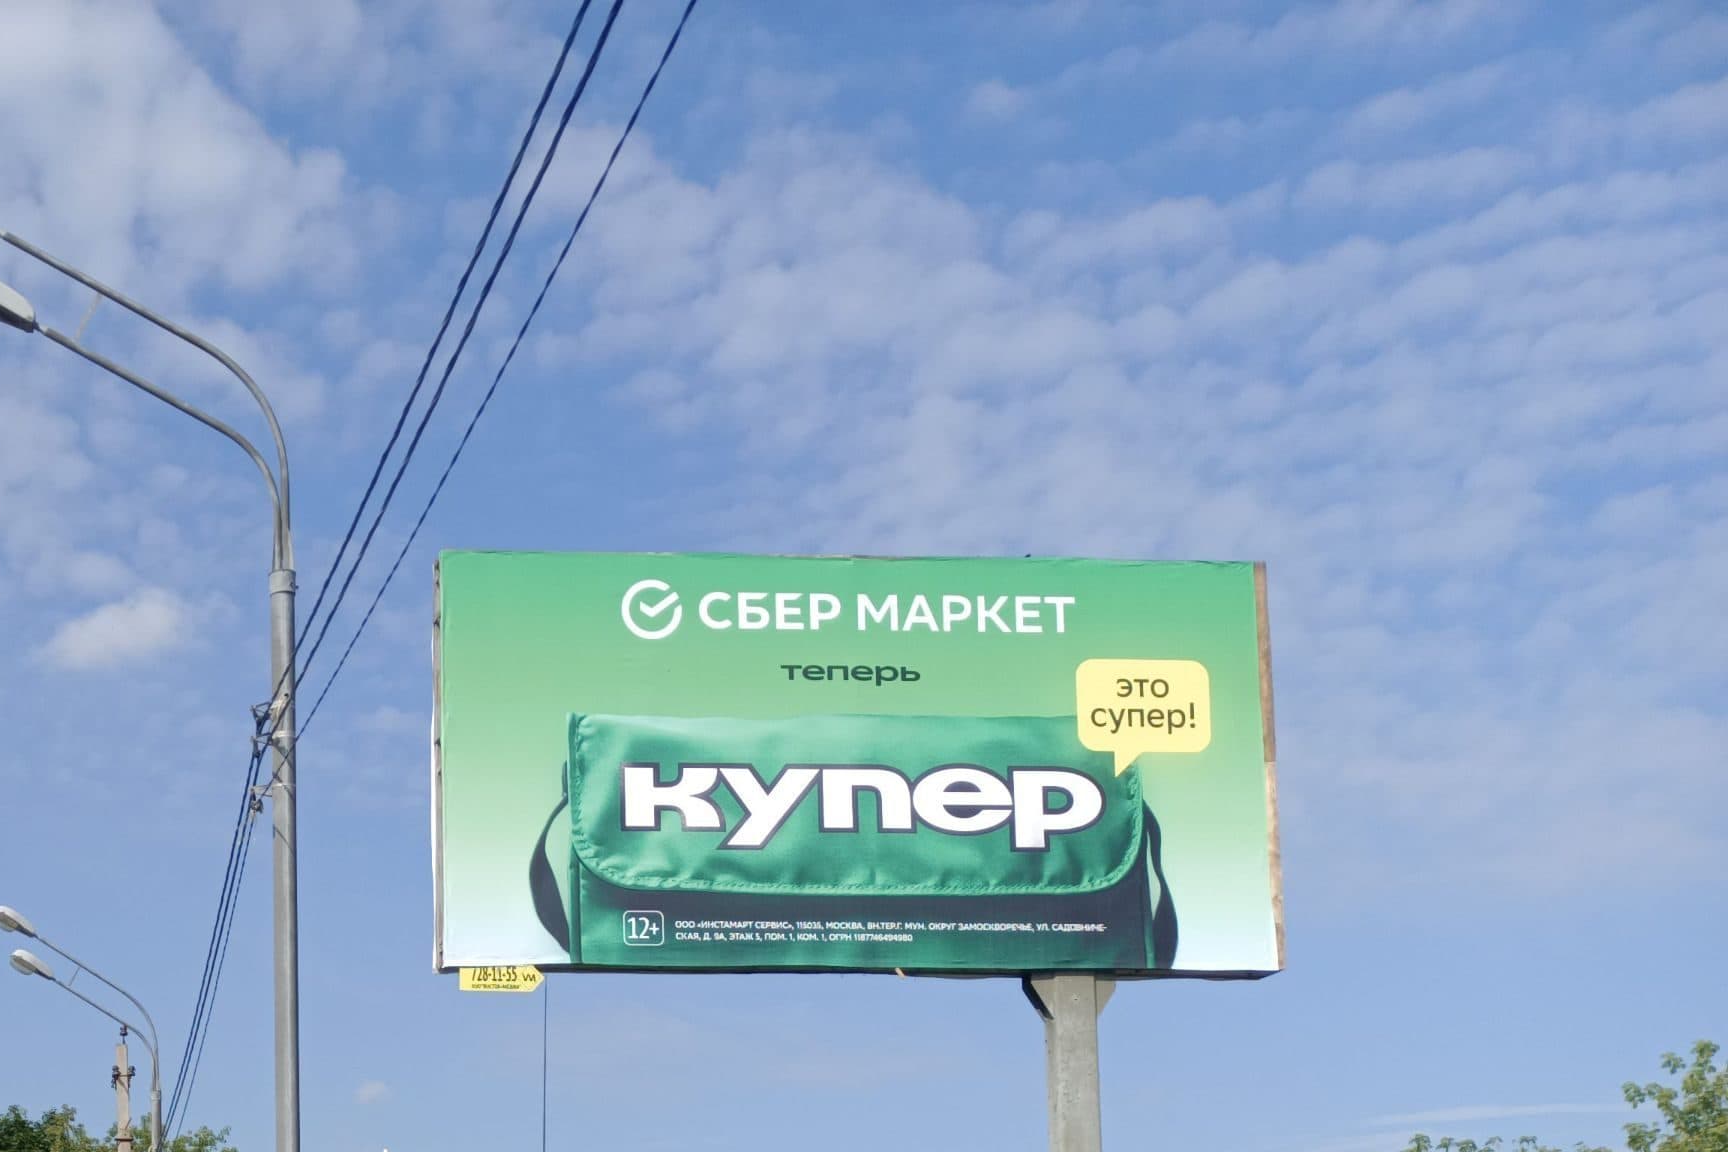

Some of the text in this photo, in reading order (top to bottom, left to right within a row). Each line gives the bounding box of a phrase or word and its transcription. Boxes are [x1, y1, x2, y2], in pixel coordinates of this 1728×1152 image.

[698, 591, 1077, 634] СБЕР МАРКЕТ
[779, 663, 922, 687] теперь
[1116, 678, 1170, 698] это
[1090, 702, 1197, 735] супер!
[620, 762, 1106, 852] купер
[626, 916, 660, 940] 12+
[674, 920, 696, 929] ООО
[928, 922, 957, 931] ОКРУГ
